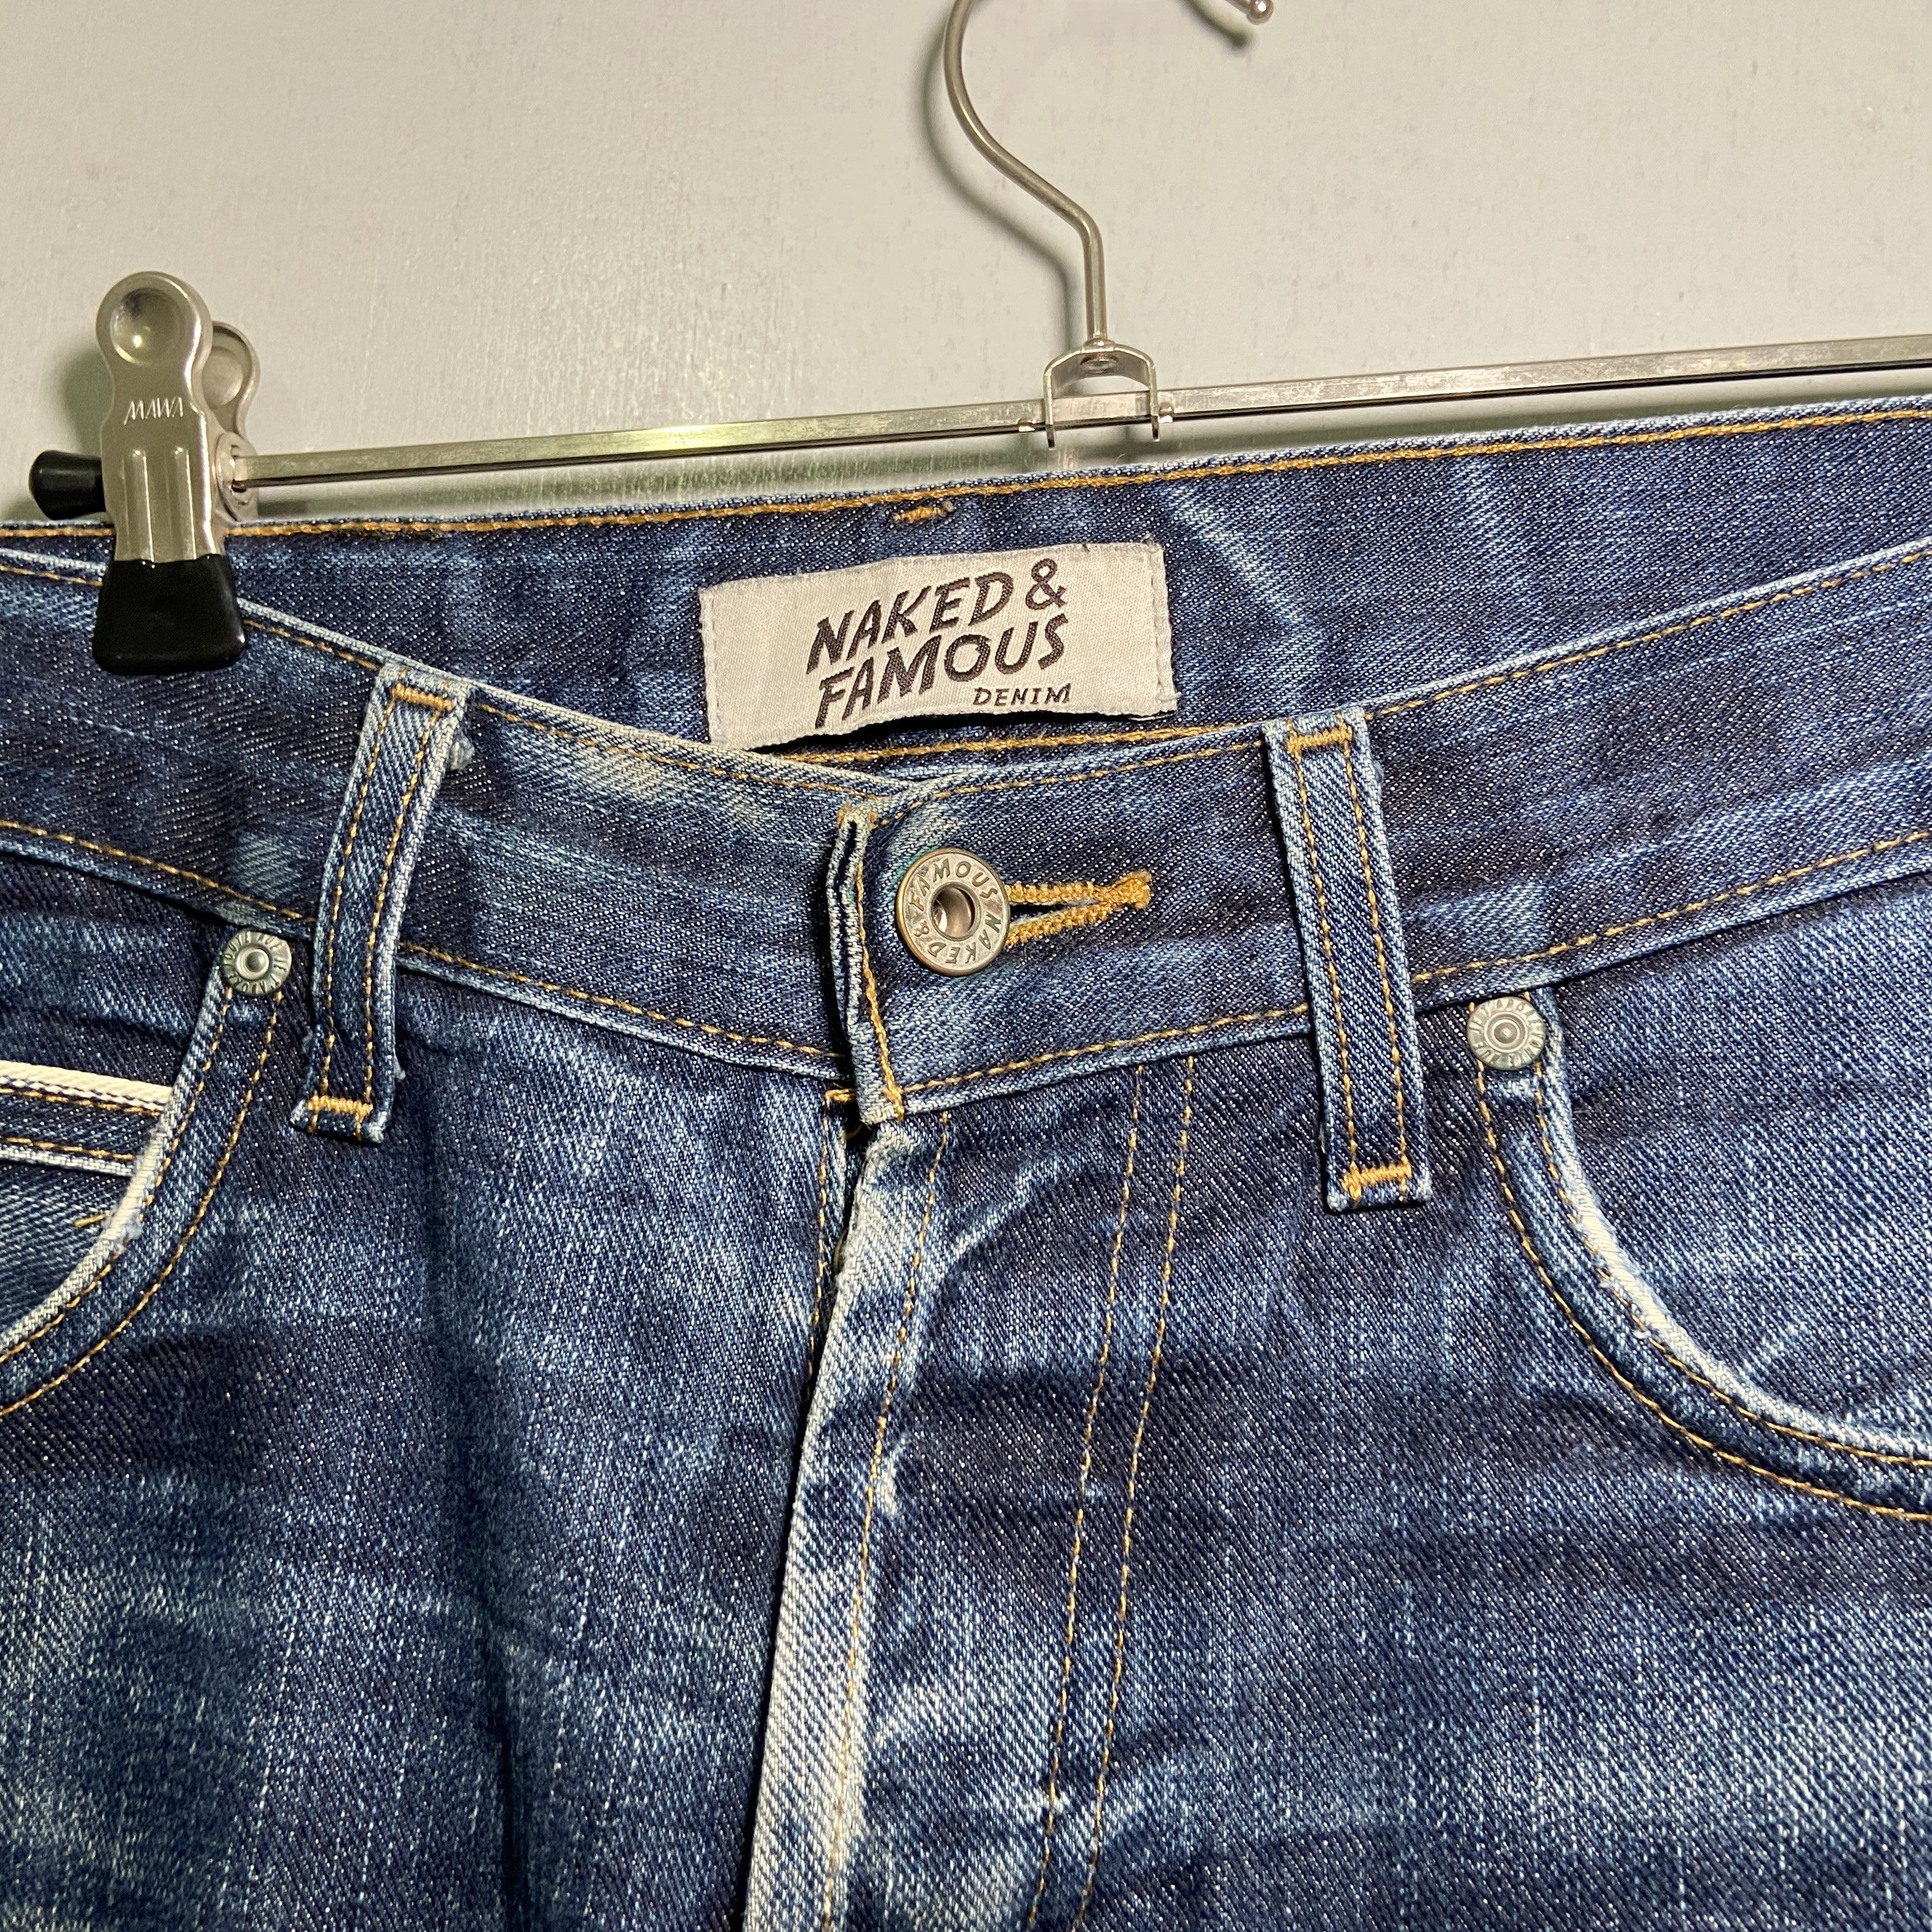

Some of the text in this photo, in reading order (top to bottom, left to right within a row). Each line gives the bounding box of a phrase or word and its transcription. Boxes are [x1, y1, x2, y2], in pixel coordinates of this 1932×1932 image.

[123, 397, 184, 425] MAWA
[806, 558, 1068, 675] NAKED &
[815, 613, 1068, 730] FAMOUS
[972, 683, 1072, 706] DENIM
[908, 858, 1001, 964] NAKED & FAMOUS
